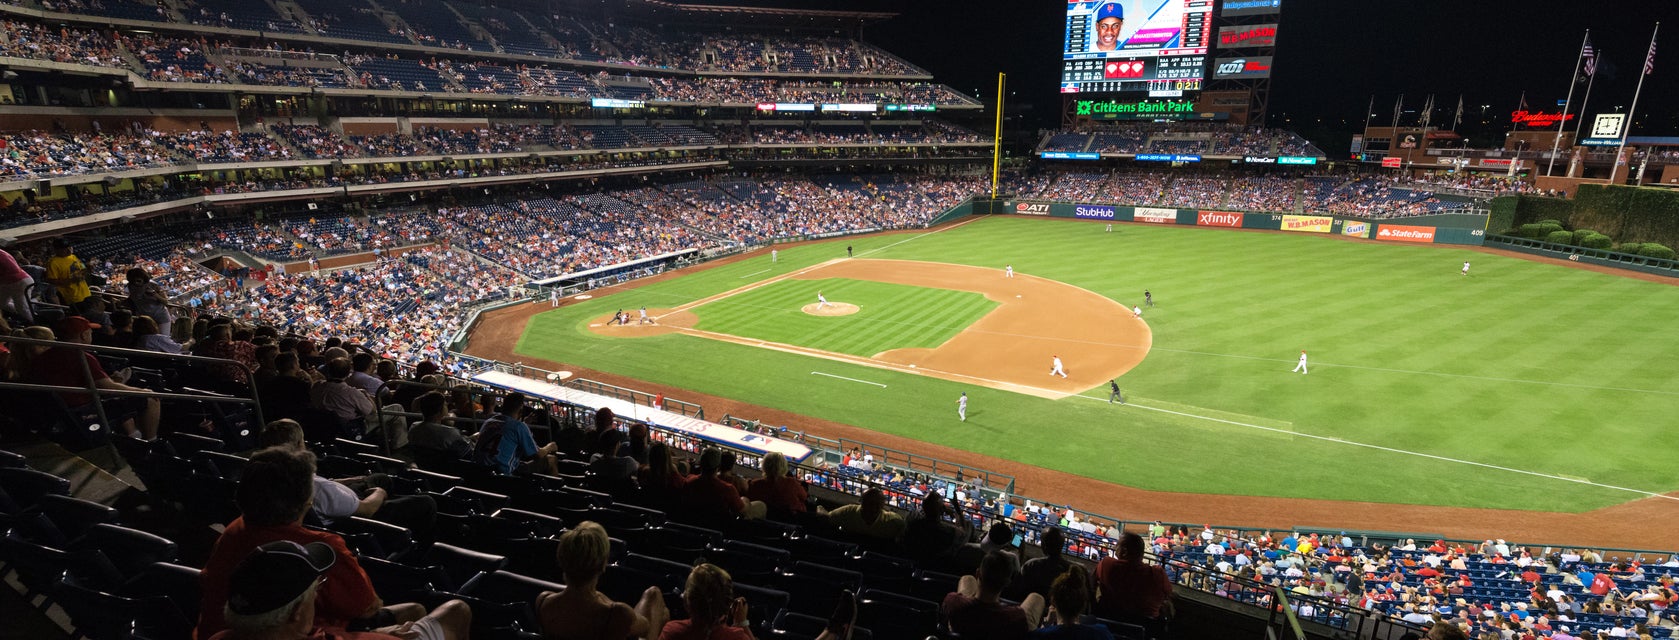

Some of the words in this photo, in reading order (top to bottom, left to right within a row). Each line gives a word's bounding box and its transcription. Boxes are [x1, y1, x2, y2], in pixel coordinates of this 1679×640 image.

[1176, 82, 1182, 90] 0
[1185, 81, 1190, 90] 2
[1194, 81, 1198, 90] 1
[1093, 100, 1136, 112] Citizens
[1138, 101, 1166, 112] Bank
[1168, 101, 1194, 112] Park
[1076, 207, 1114, 217] StubHub
[1201, 213, 1239, 226] xfinity
